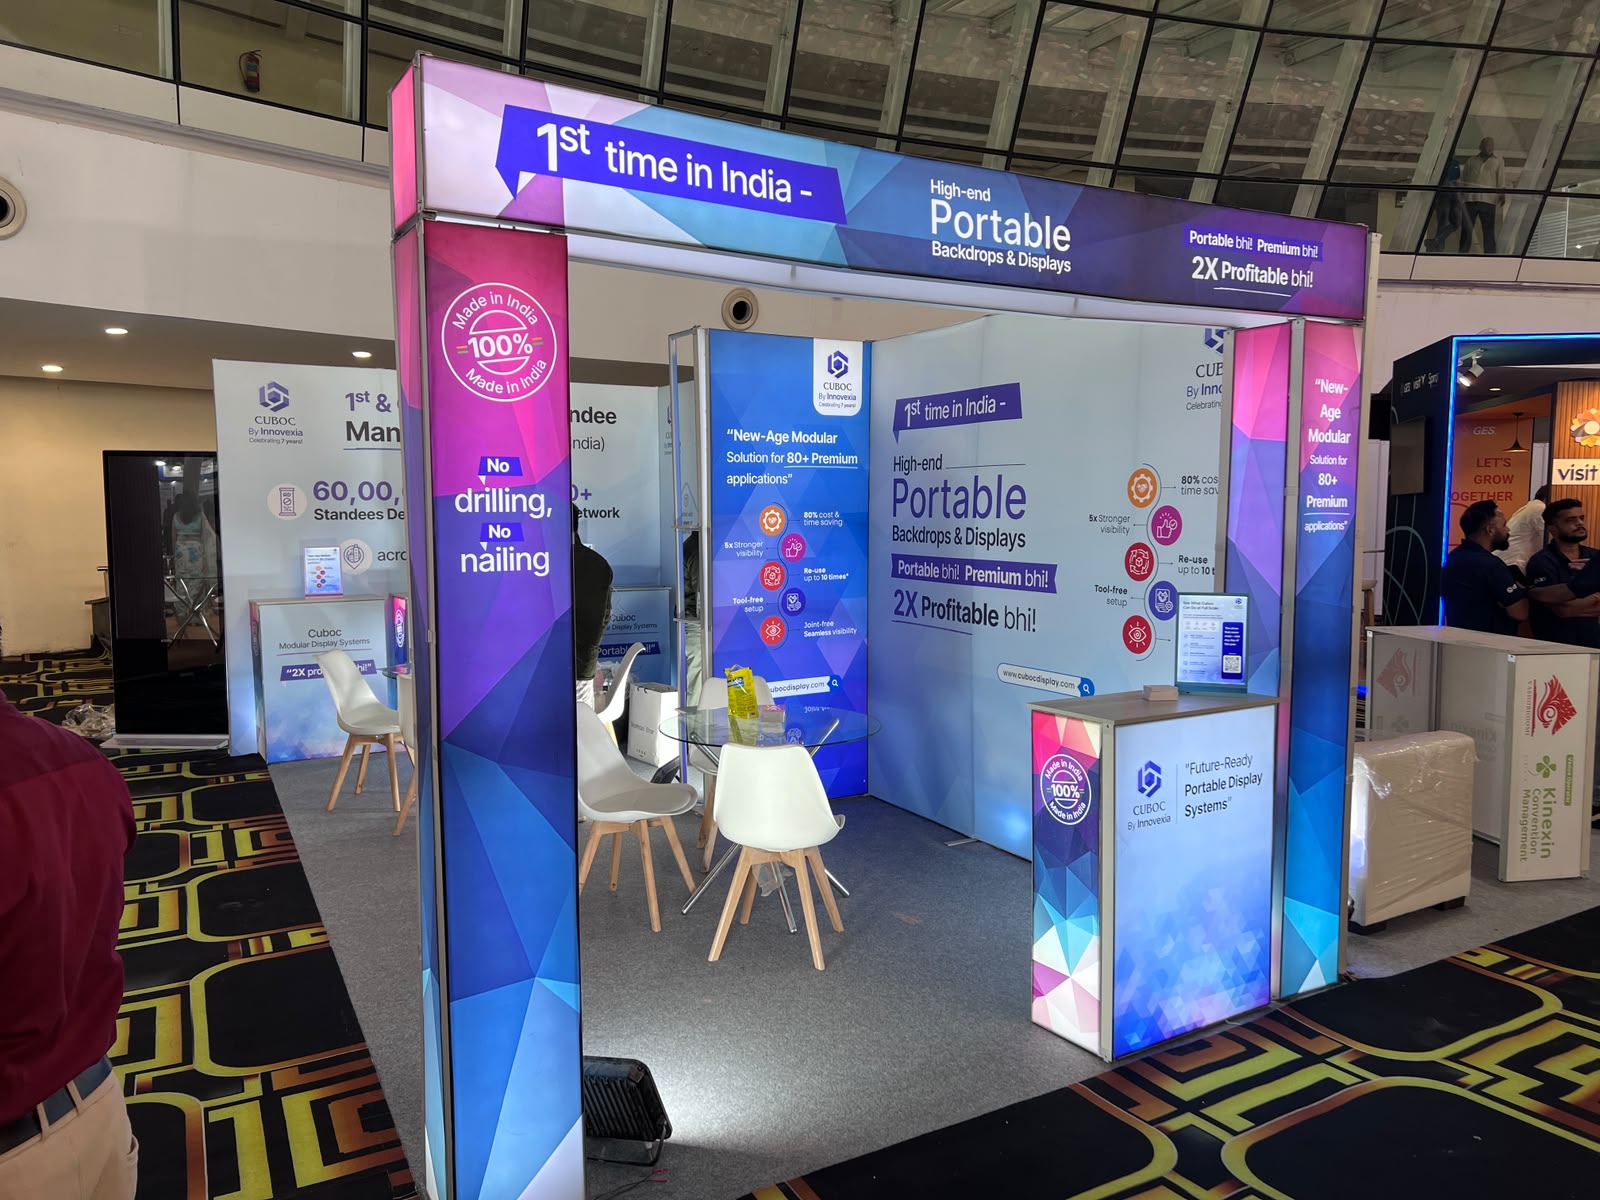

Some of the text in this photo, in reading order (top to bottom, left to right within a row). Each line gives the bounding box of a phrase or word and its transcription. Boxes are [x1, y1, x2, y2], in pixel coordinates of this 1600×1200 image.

[536, 123, 591, 171] 1st
[605, 140, 678, 182] time
[686, 153, 713, 191] in
[722, 160, 792, 202] India
[930, 178, 991, 202] High-end
[930, 199, 1071, 251] Portable
[1189, 230, 1318, 259] Portable bhi! Premium bhi!
[932, 240, 1072, 275] Backdrops & Displays
[1191, 255, 1313, 288] 2X Profitable bhi!
[452, 291, 538, 330] Made in India
[468, 333, 533, 358] 100%
[465, 359, 547, 394] Made in India
[1196, 362, 1223, 377] CUB
[823, 382, 852, 391] CUBOC
[1186, 386, 1199, 399] By
[345, 391, 392, 412] 1st &
[818, 393, 857, 401] By Innovexia
[570, 406, 617, 424] ndee
[904, 399, 921, 427] 1st
[924, 403, 949, 420] time
[952, 400, 962, 418] in
[965, 395, 996, 416] India
[1320, 404, 1341, 422] Age
[254, 416, 296, 426] CUBOC
[248, 427, 303, 437] By Innovexia
[346, 421, 400, 442] Man
[791, 431, 838, 444] Modular
[1308, 429, 1351, 444] Modular
[573, 436, 605, 452] ndia)
[487, 458, 510, 473] No
[726, 451, 858, 465] Solution for 80+ Premium
[893, 454, 942, 476] High-end
[1310, 454, 1348, 466] Solution for
[1181, 475, 1218, 484] 80% cos
[1318, 473, 1337, 486] 80+
[1473, 474, 1514, 485] GROW
[1557, 464, 1599, 481] visit
[313, 481, 399, 506] 60,00,
[892, 474, 1027, 520] Portable
[1181, 486, 1201, 495] time
[1451, 491, 1513, 502] OGETHER
[454, 487, 552, 519] drilling,
[1306, 495, 1347, 508] Premium
[314, 508, 384, 520] Standees
[578, 507, 620, 519] etwork
[1098, 514, 1131, 525] Stronger
[820, 519, 842, 527] saving
[1100, 525, 1130, 536] visibility
[488, 524, 511, 538] No
[892, 524, 1026, 552] Backdrops & Displays
[734, 541, 764, 549] Stronger
[736, 549, 764, 557] visibility
[1179, 555, 1208, 564] Re-use
[461, 546, 550, 577] nailing
[898, 560, 1048, 587] Portable bhi! Premium bhi!
[1178, 567, 1189, 576] up
[1191, 565, 1200, 574] to
[1201, 567, 1210, 575] 10
[1094, 584, 1128, 595] Tool-free
[1106, 597, 1128, 608] setup
[894, 589, 1036, 632] 2X Profitable bhi!
[308, 628, 342, 638] Cuboc
[803, 628, 857, 638] Seamless visibility
[279, 637, 370, 649] Modular Display Systems
[1002, 669, 1075, 689] www.cubocdisplay.com
[770, 682, 825, 693] ubocdisplay.com
[1045, 759, 1083, 782] Made in India
[1051, 784, 1080, 798] 100%
[1185, 772, 1263, 796] Portable Display
[1049, 801, 1087, 820] Made in India
[1133, 801, 1166, 816] CUBOC
[1127, 814, 1171, 832] By Innovexia
[1520, 789, 1530, 862] Management
[1529, 788, 1541, 855] Convention
[1540, 787, 1556, 859] Kinexin
